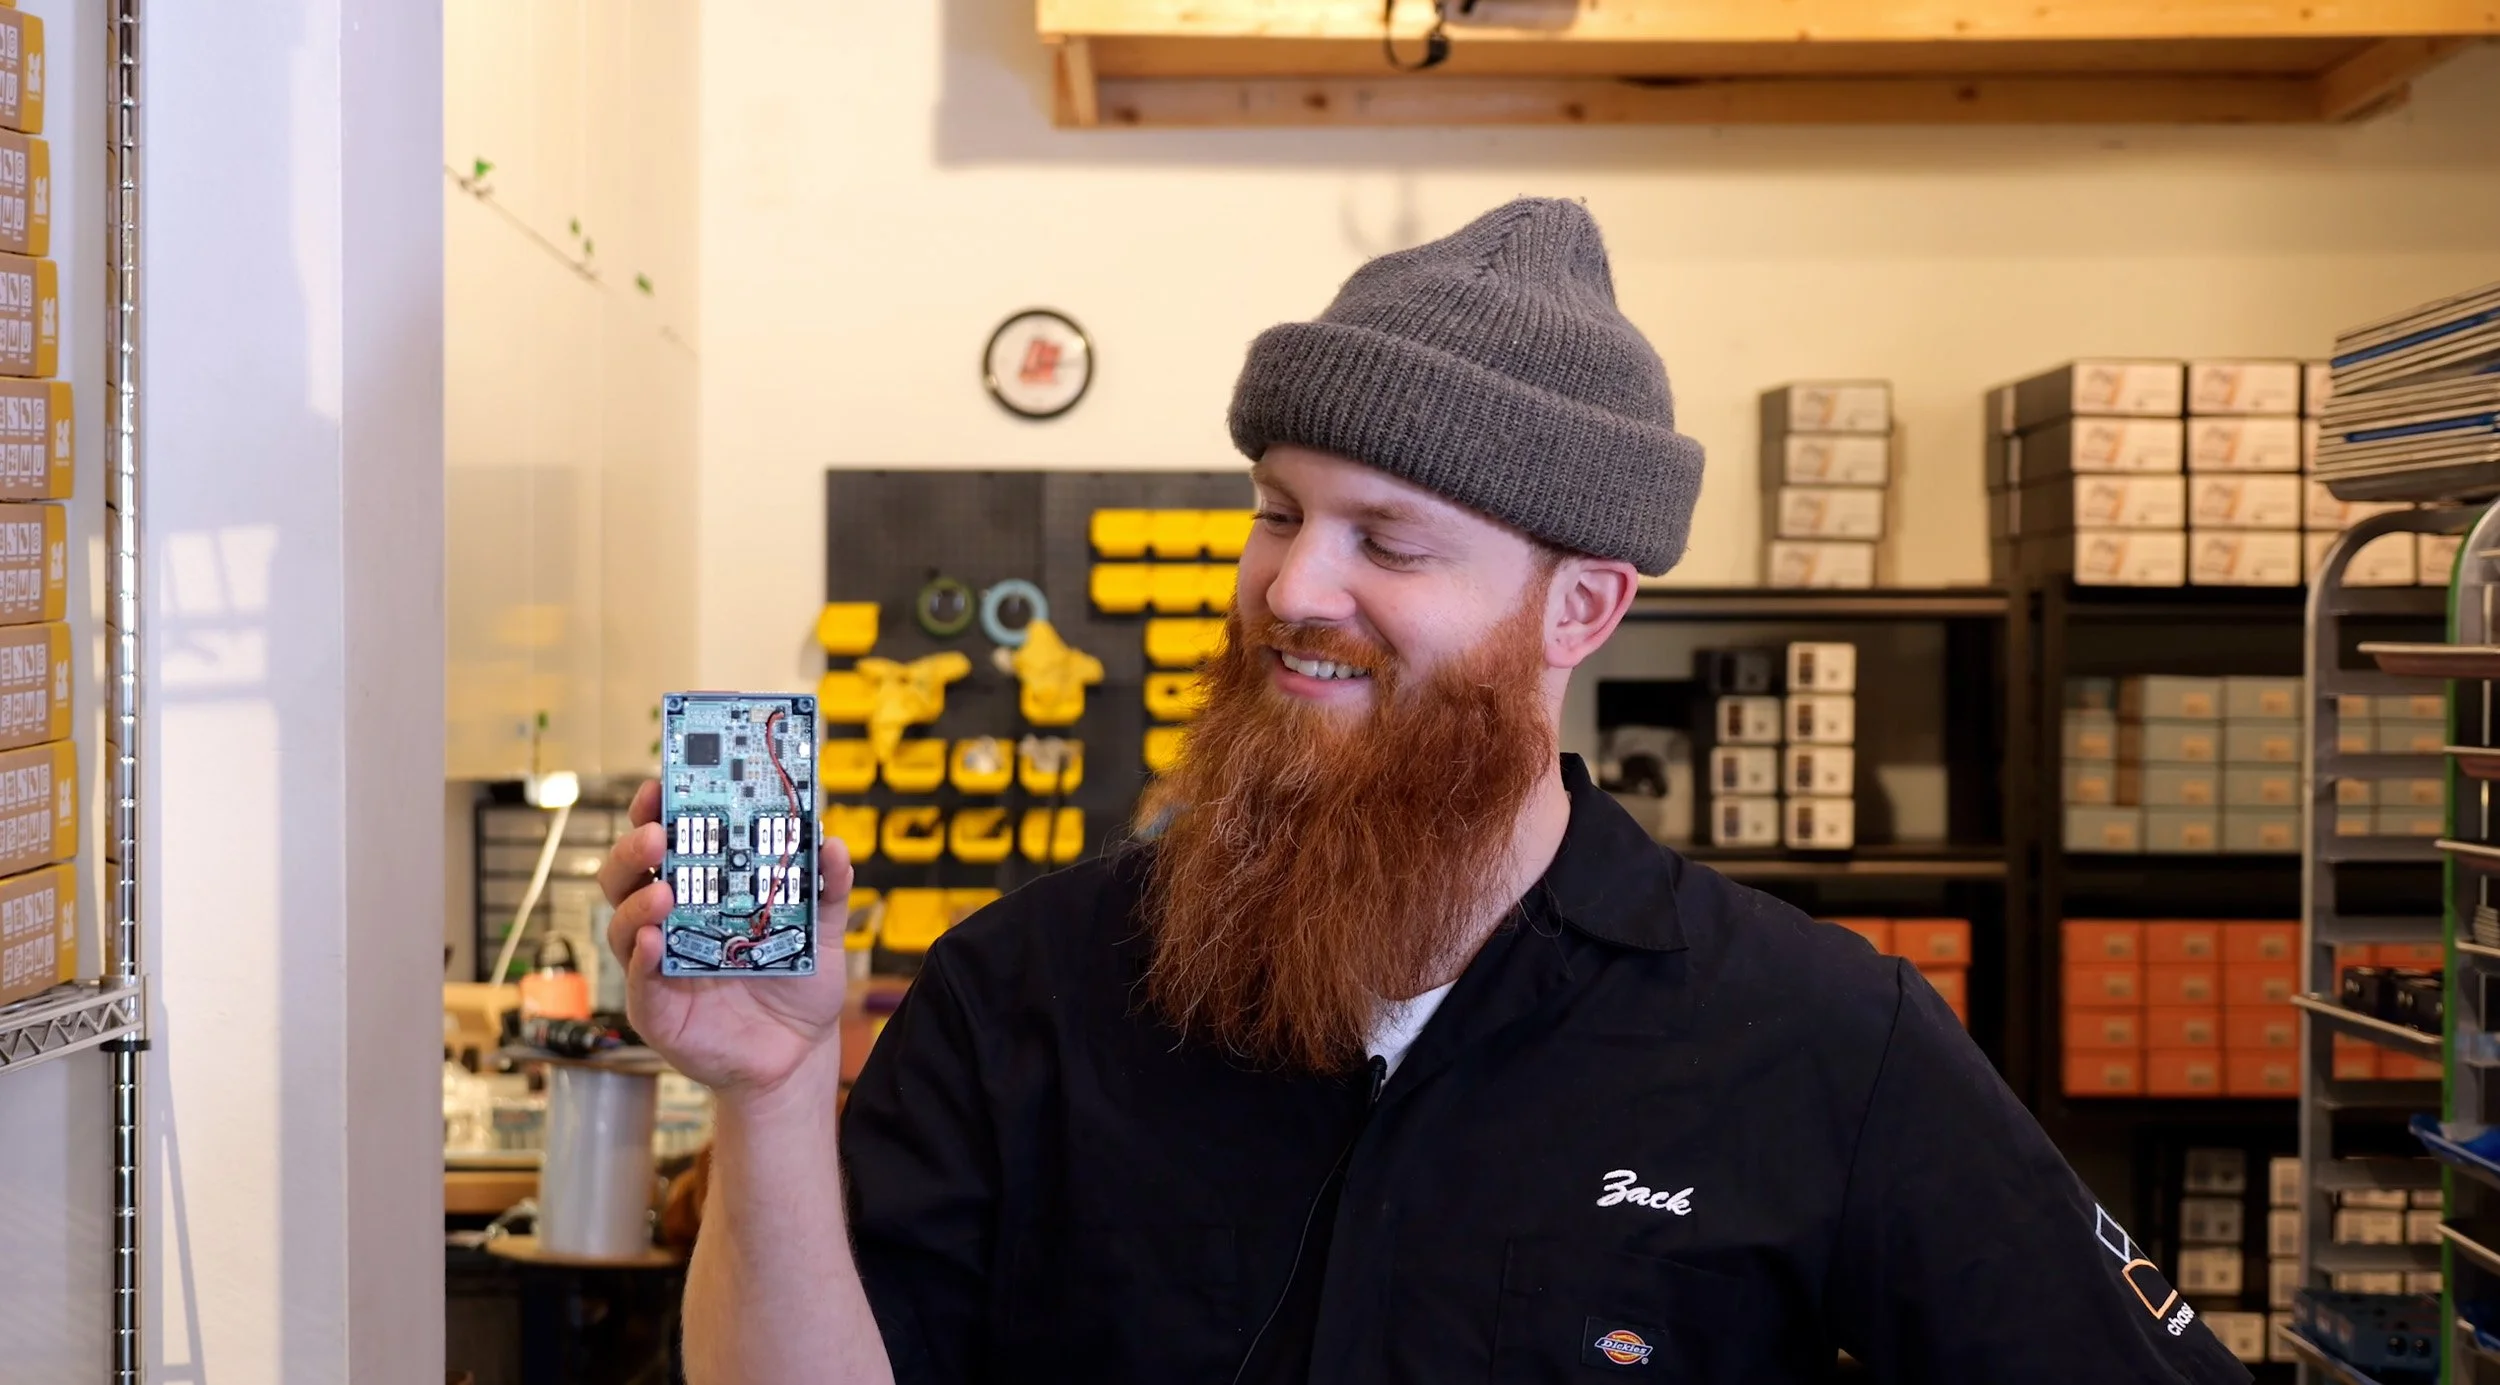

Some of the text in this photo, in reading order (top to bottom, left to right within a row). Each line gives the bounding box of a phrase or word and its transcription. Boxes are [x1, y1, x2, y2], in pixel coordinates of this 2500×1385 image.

[1597, 1169, 1694, 1216] Zack
[2167, 1302, 2195, 1336] chas
[1601, 1339, 1648, 1355] Dickies
